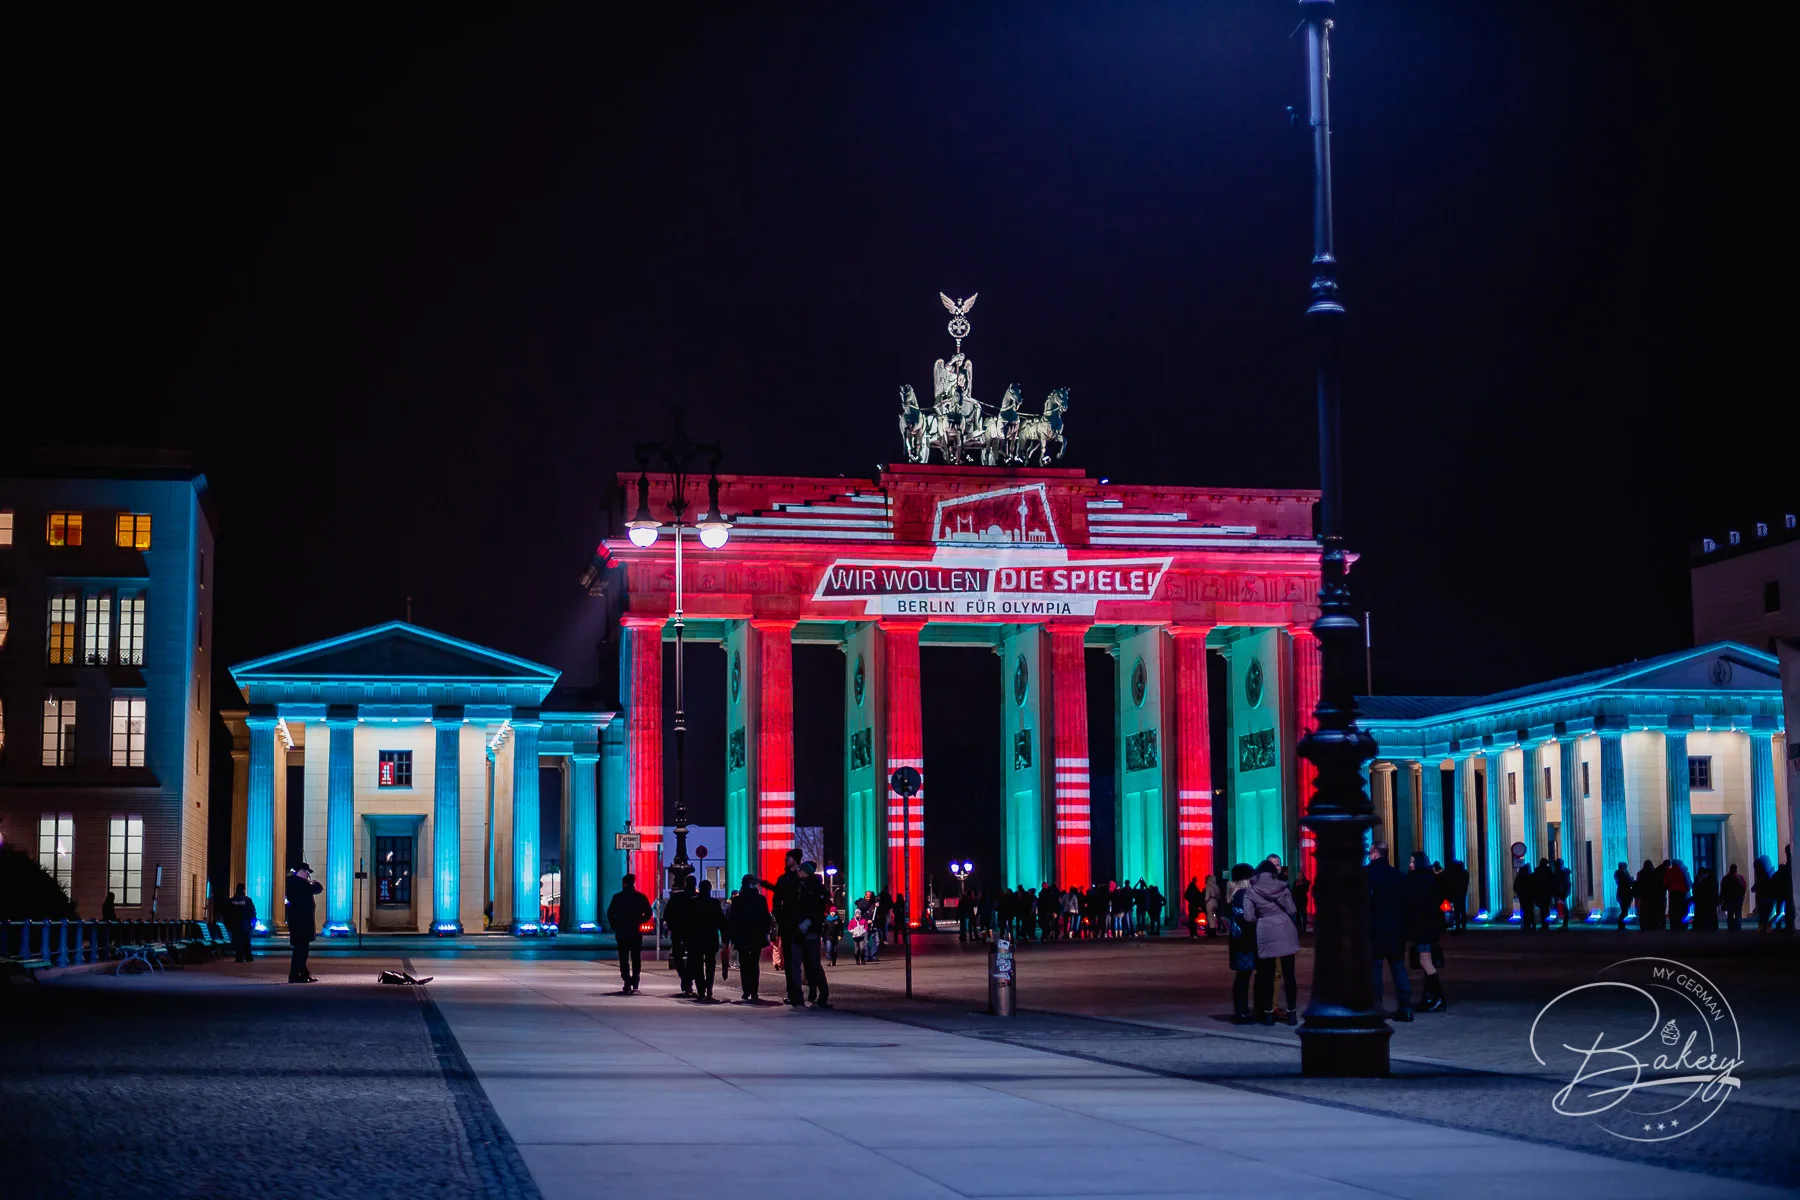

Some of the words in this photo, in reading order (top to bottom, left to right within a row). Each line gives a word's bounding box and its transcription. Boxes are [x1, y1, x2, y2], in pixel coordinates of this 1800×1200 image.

[831, 570, 876, 589] WIR
[882, 570, 979, 590] WOLLEN
[1001, 569, 1044, 589] DIE
[1054, 570, 1153, 591] SPIELE!
[898, 601, 954, 613] BERLIN
[967, 598, 996, 613] FÜR
[1002, 601, 1071, 614] OLYMPIA
